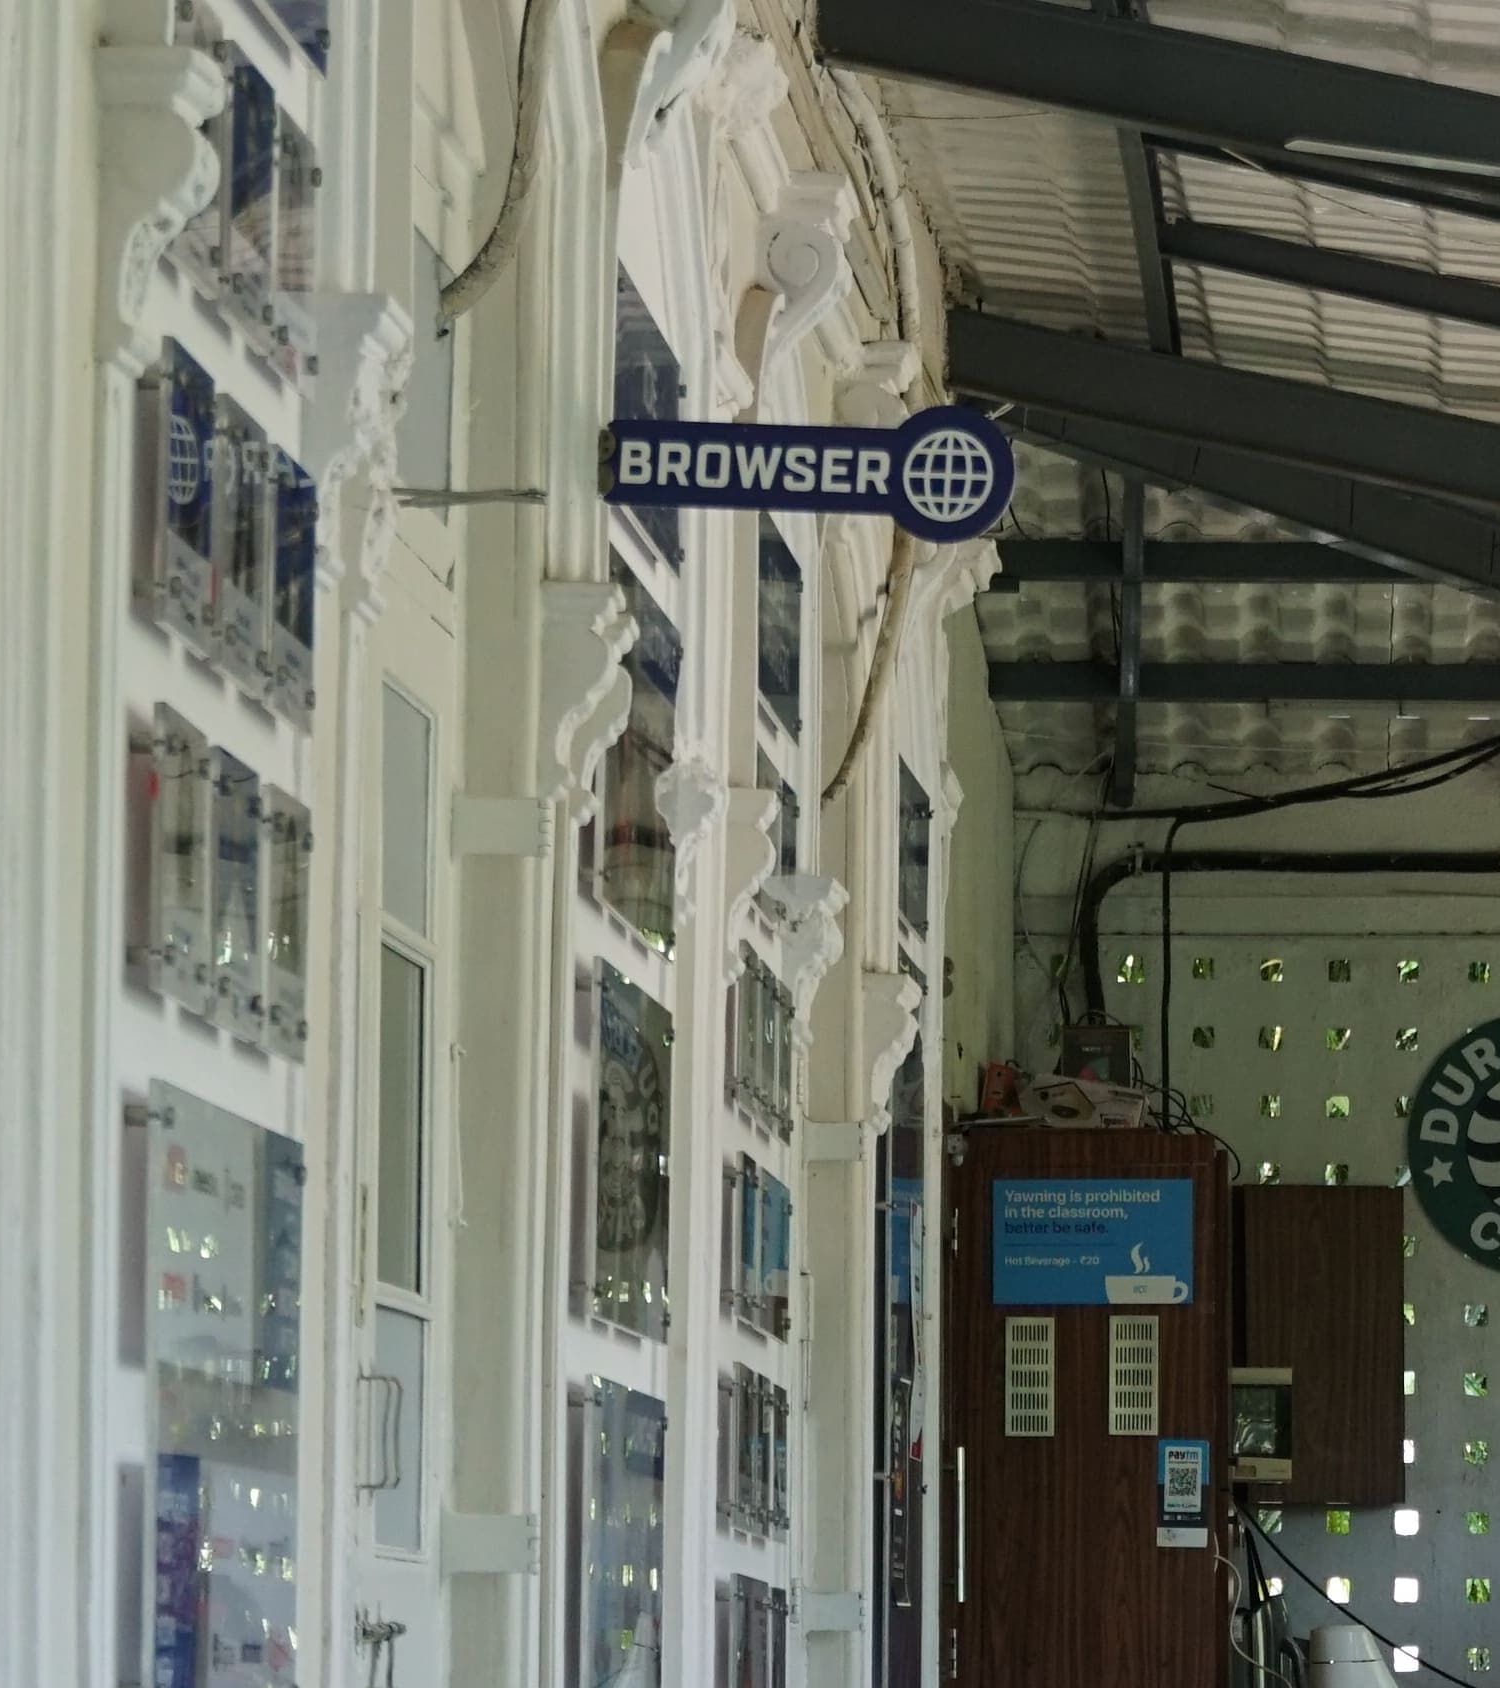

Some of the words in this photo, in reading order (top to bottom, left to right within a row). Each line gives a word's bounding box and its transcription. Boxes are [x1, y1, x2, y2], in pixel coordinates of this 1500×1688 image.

[618, 440, 891, 495] BROWSER
[1004, 1188, 1067, 1205] Yawning
[1069, 1189, 1080, 1203] is
[1085, 1188, 1162, 1204] prohibited
[1004, 1205, 1019, 1219] in
[1021, 1205, 1045, 1219] the
[1048, 1204, 1129, 1220] classroom,
[1004, 1220, 1050, 1234] better
[1052, 1221, 1071, 1234] be
[1074, 1220, 1109, 1234] safe.
[1004, 1255, 1023, 1266] Hot
[1024, 1255, 1070, 1267] Beverage
[1079, 1255, 1100, 1265] ₹20
